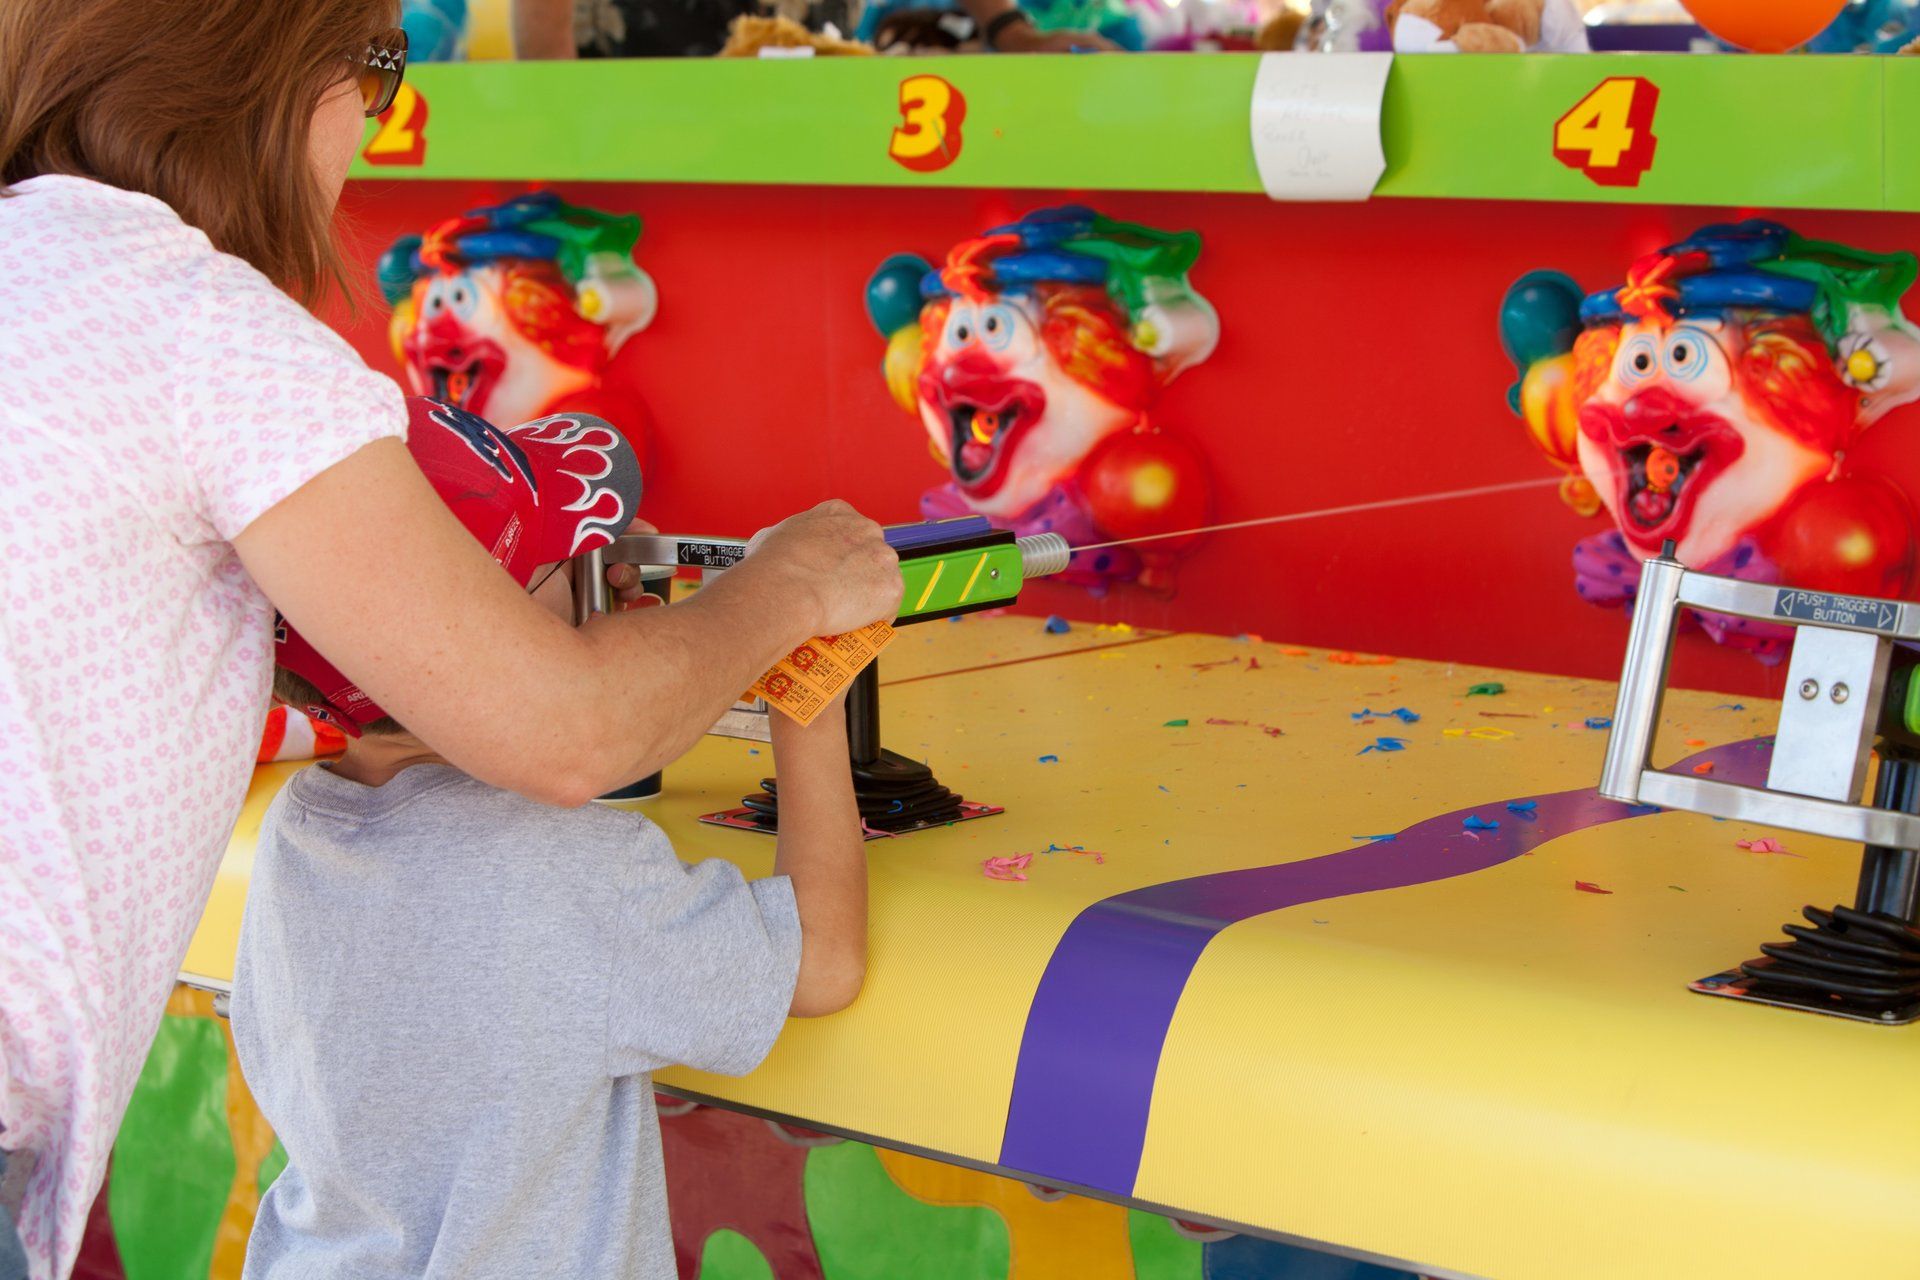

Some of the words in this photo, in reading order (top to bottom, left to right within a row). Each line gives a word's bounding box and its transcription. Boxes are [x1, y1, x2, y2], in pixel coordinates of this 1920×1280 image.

[362, 80, 429, 167] 2
[888, 74, 967, 172] 3
[1553, 75, 1660, 187] 4
[690, 544, 712, 555] PUSH
[704, 555, 736, 567] BUTTON
[1796, 592, 1828, 607] PUSH
[1832, 597, 1878, 614] TRIGGER
[1813, 607, 1857, 624] BUTTON
